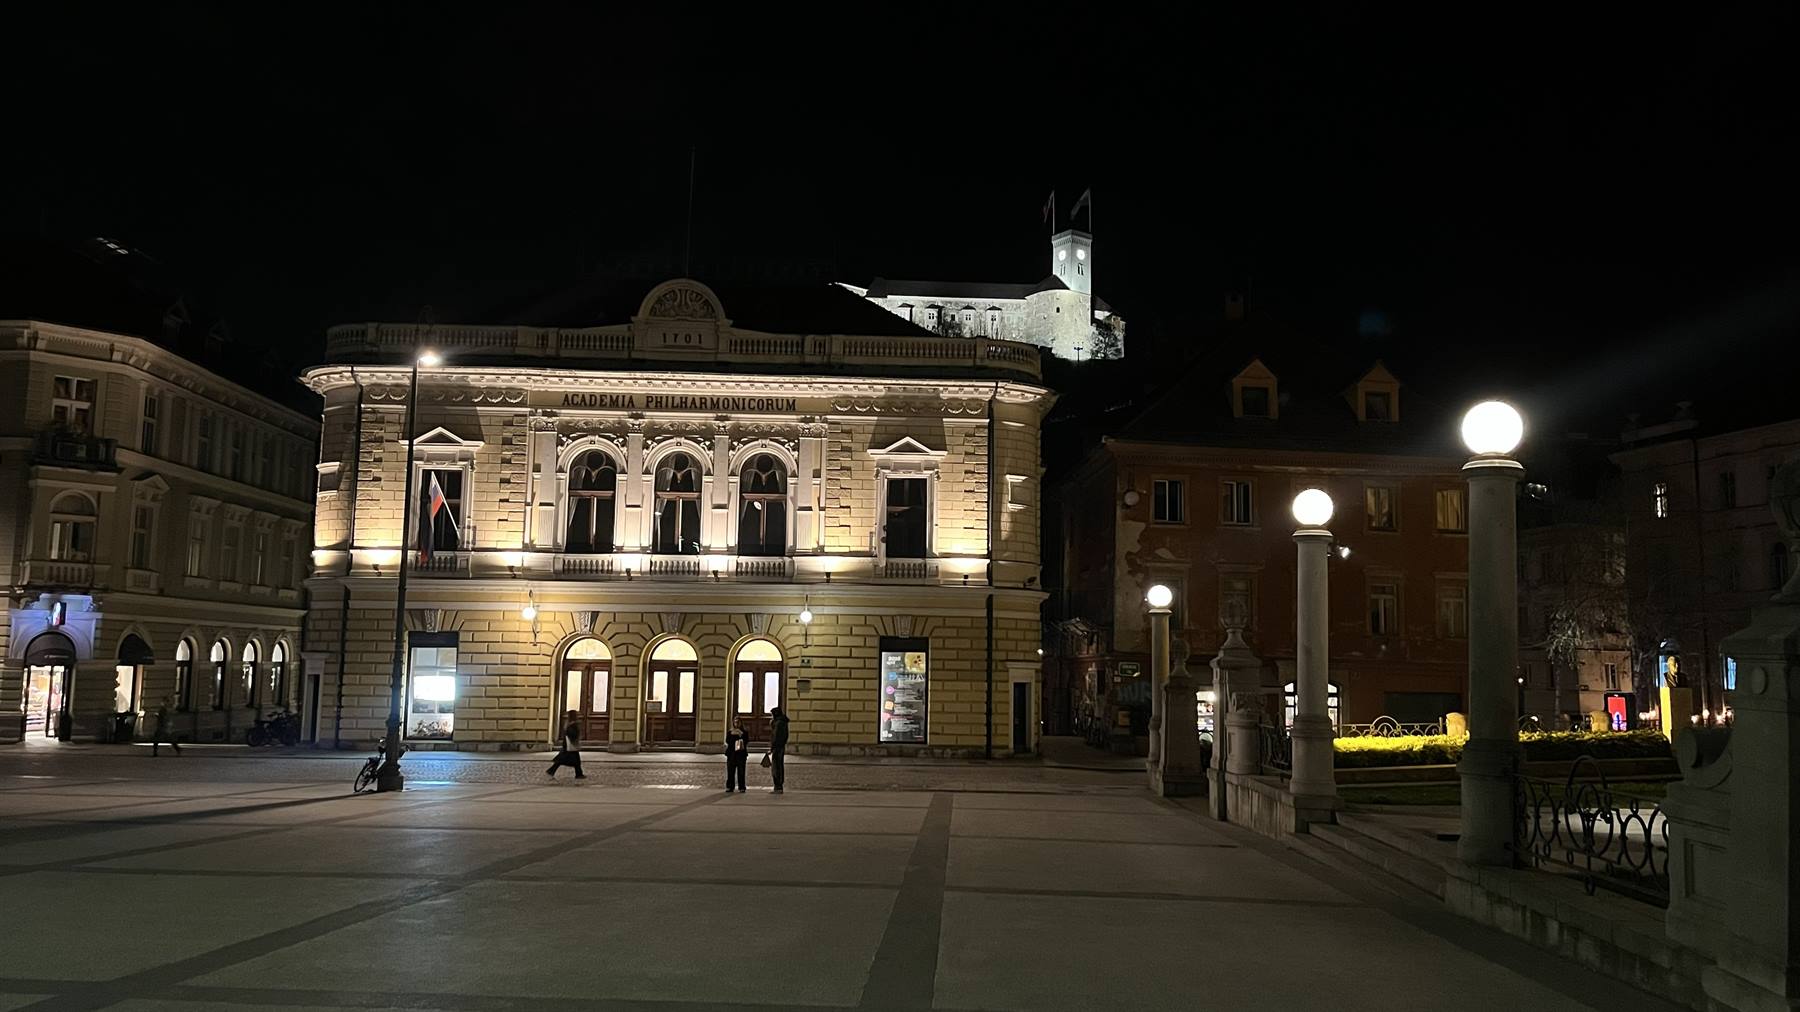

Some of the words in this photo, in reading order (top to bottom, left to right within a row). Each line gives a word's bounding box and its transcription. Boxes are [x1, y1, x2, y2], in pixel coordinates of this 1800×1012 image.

[663, 333, 703, 344] 1701
[562, 393, 635, 407] ACADEMIA
[646, 395, 796, 411] PHILHARMONICORUM
